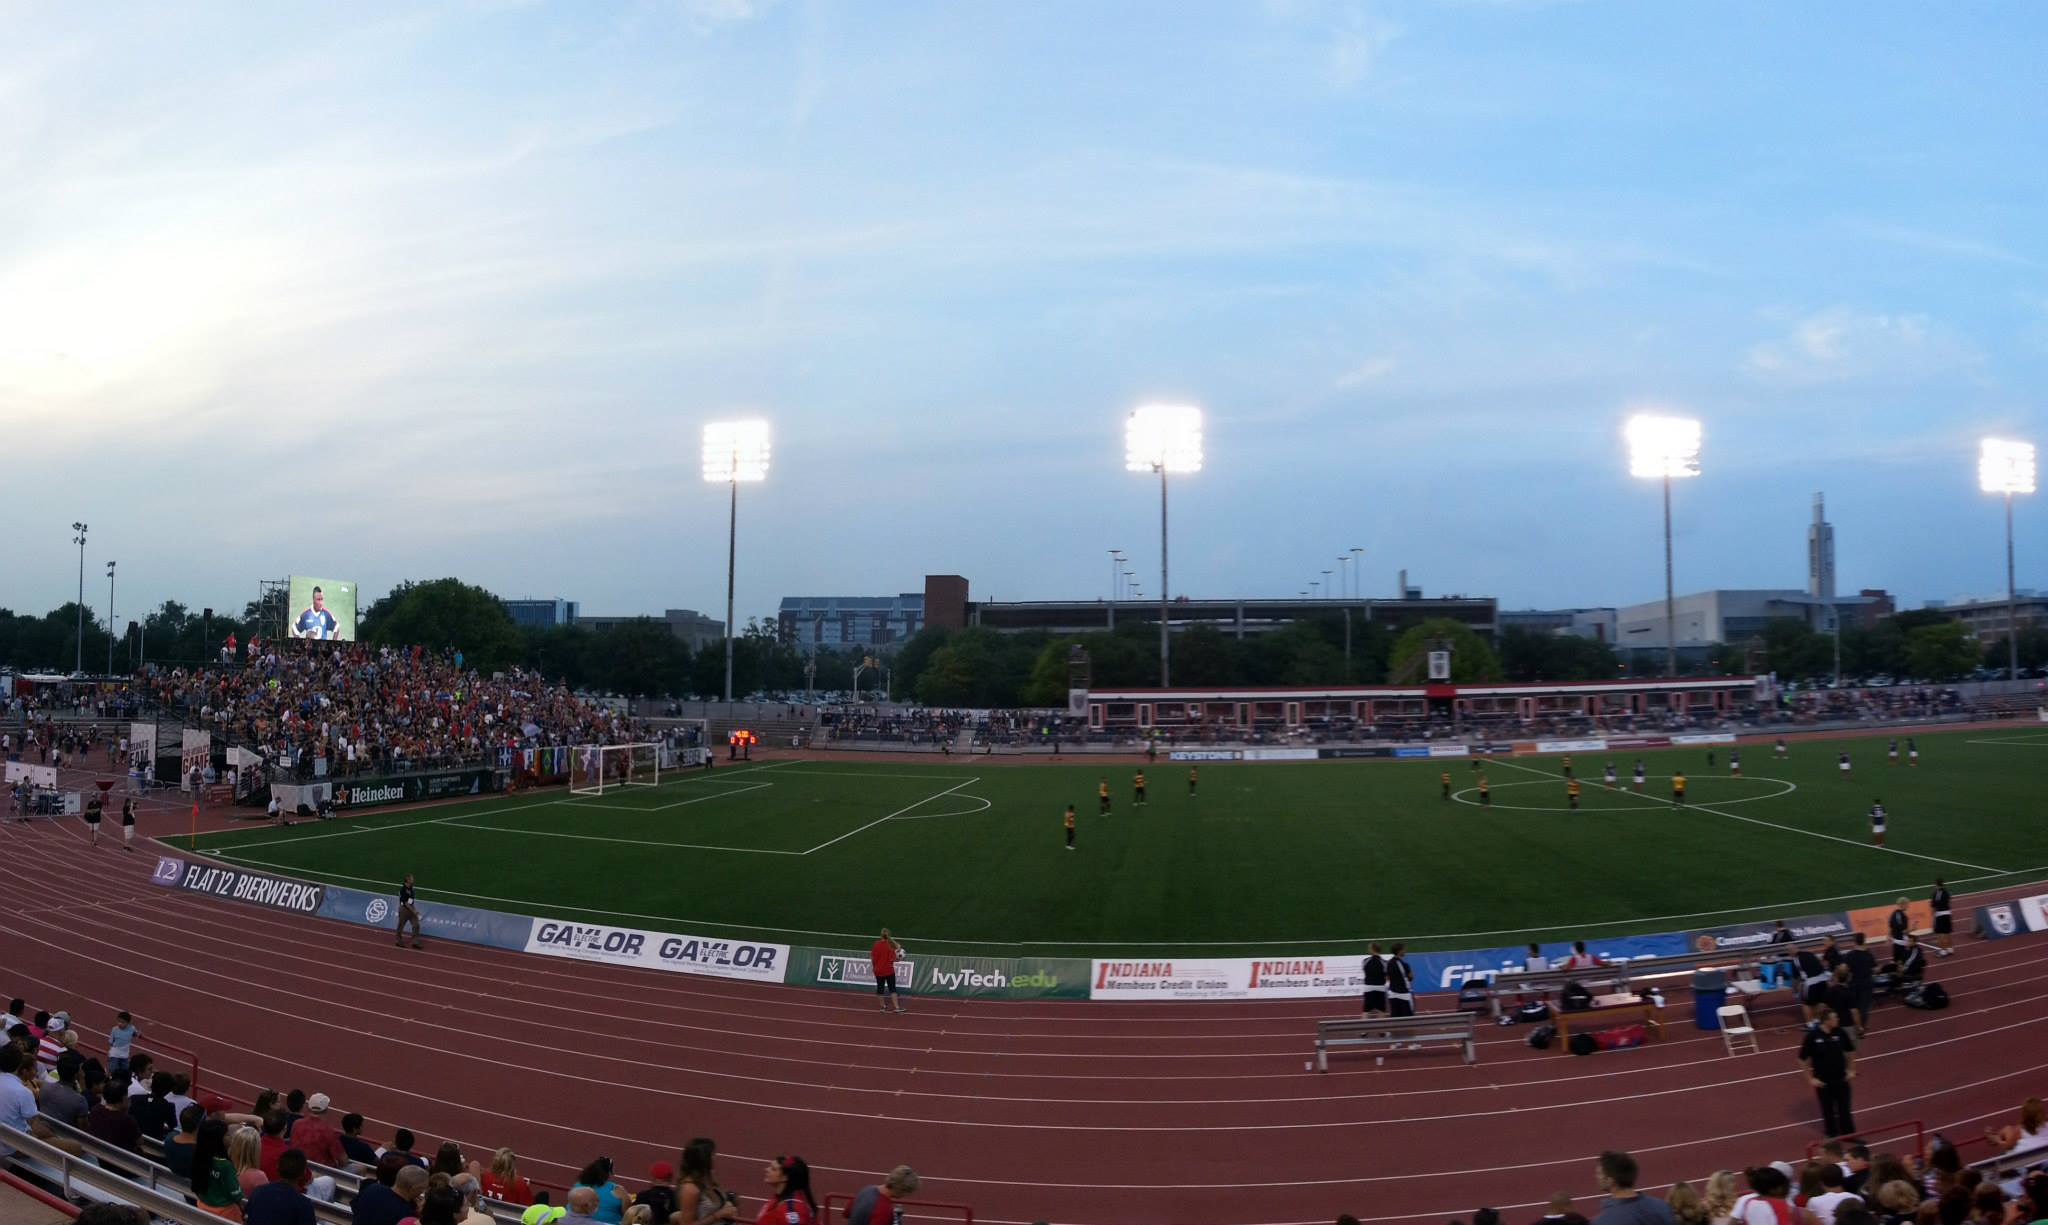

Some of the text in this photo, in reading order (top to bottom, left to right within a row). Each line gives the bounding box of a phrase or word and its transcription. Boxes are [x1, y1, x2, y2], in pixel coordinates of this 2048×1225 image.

[351, 785, 404, 804] Heineken
[155, 861, 177, 880] 12
[183, 866, 321, 912] FLAT 12 BIERWERKS
[537, 923, 645, 955] GAYLOR
[659, 938, 777, 969] GAYLOR
[847, 962, 870, 975] IVY
[1095, 962, 1173, 989] INDIANA
[1248, 960, 1325, 988] INDIANA
